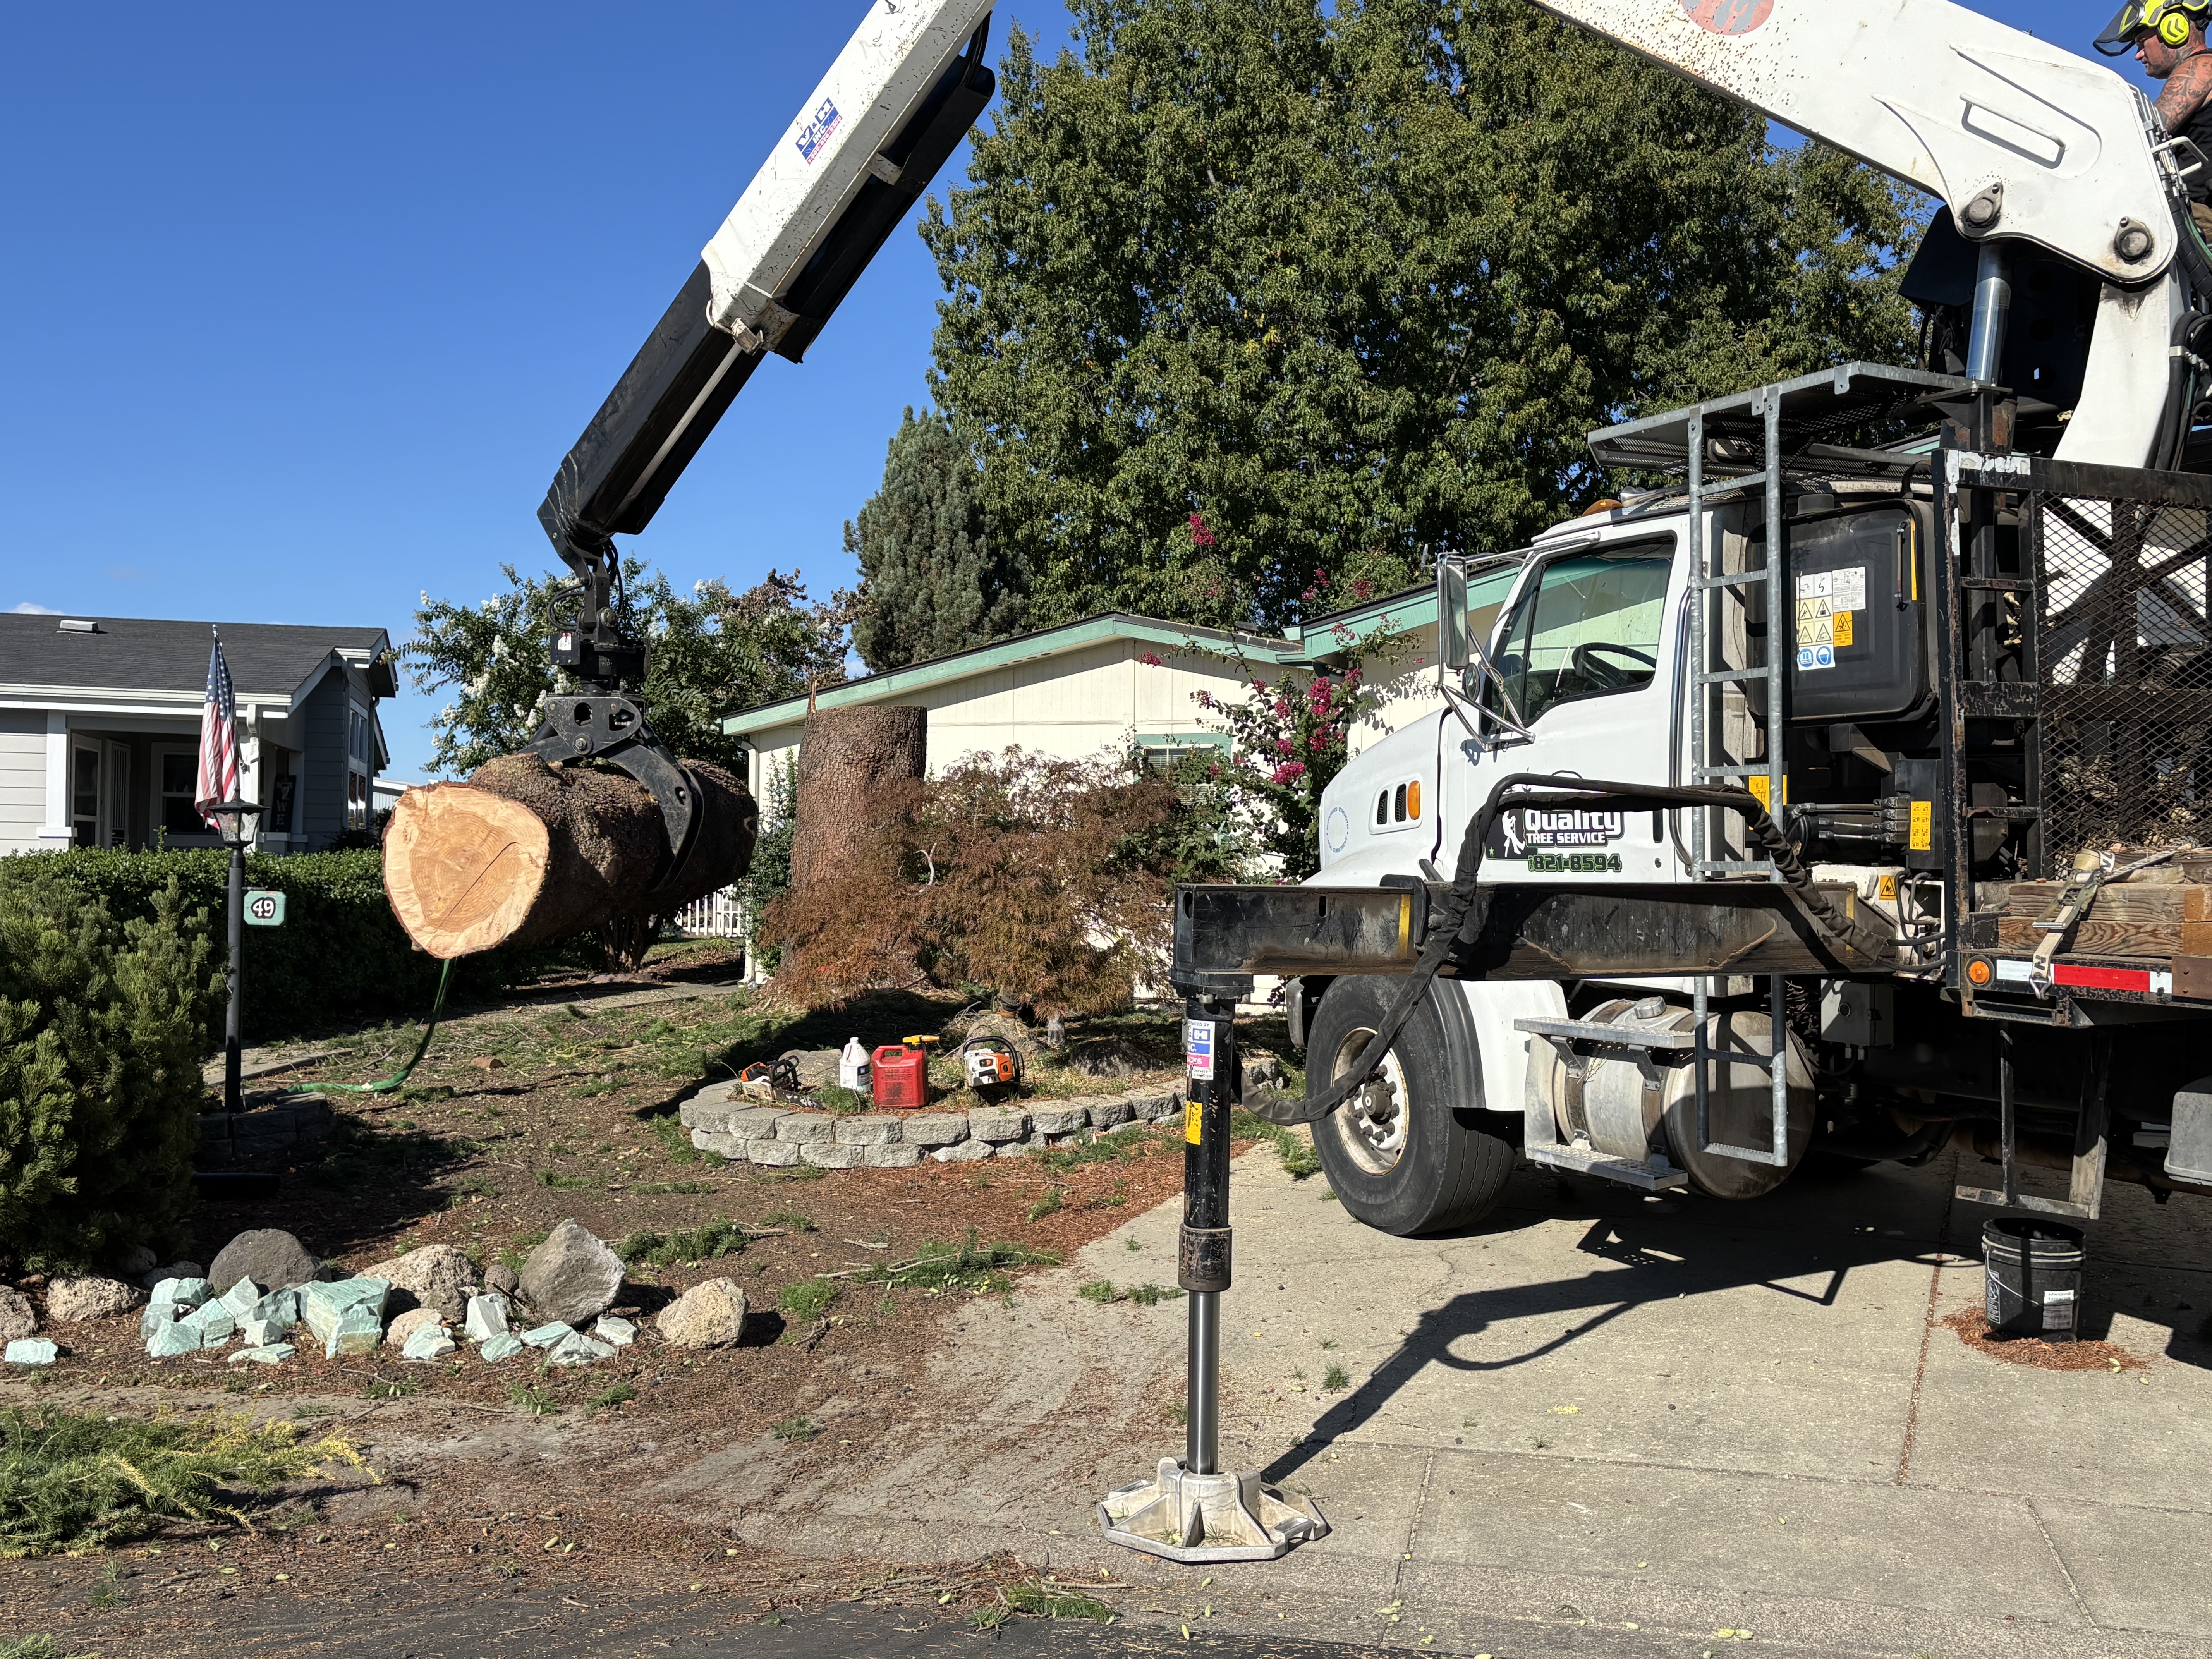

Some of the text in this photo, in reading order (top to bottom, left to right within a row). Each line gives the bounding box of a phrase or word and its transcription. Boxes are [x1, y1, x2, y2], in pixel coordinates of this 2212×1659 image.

[1525, 809, 1621, 835] Quality
[1526, 832, 1606, 844] TREE SERVICE
[252, 899, 275, 917] 49
